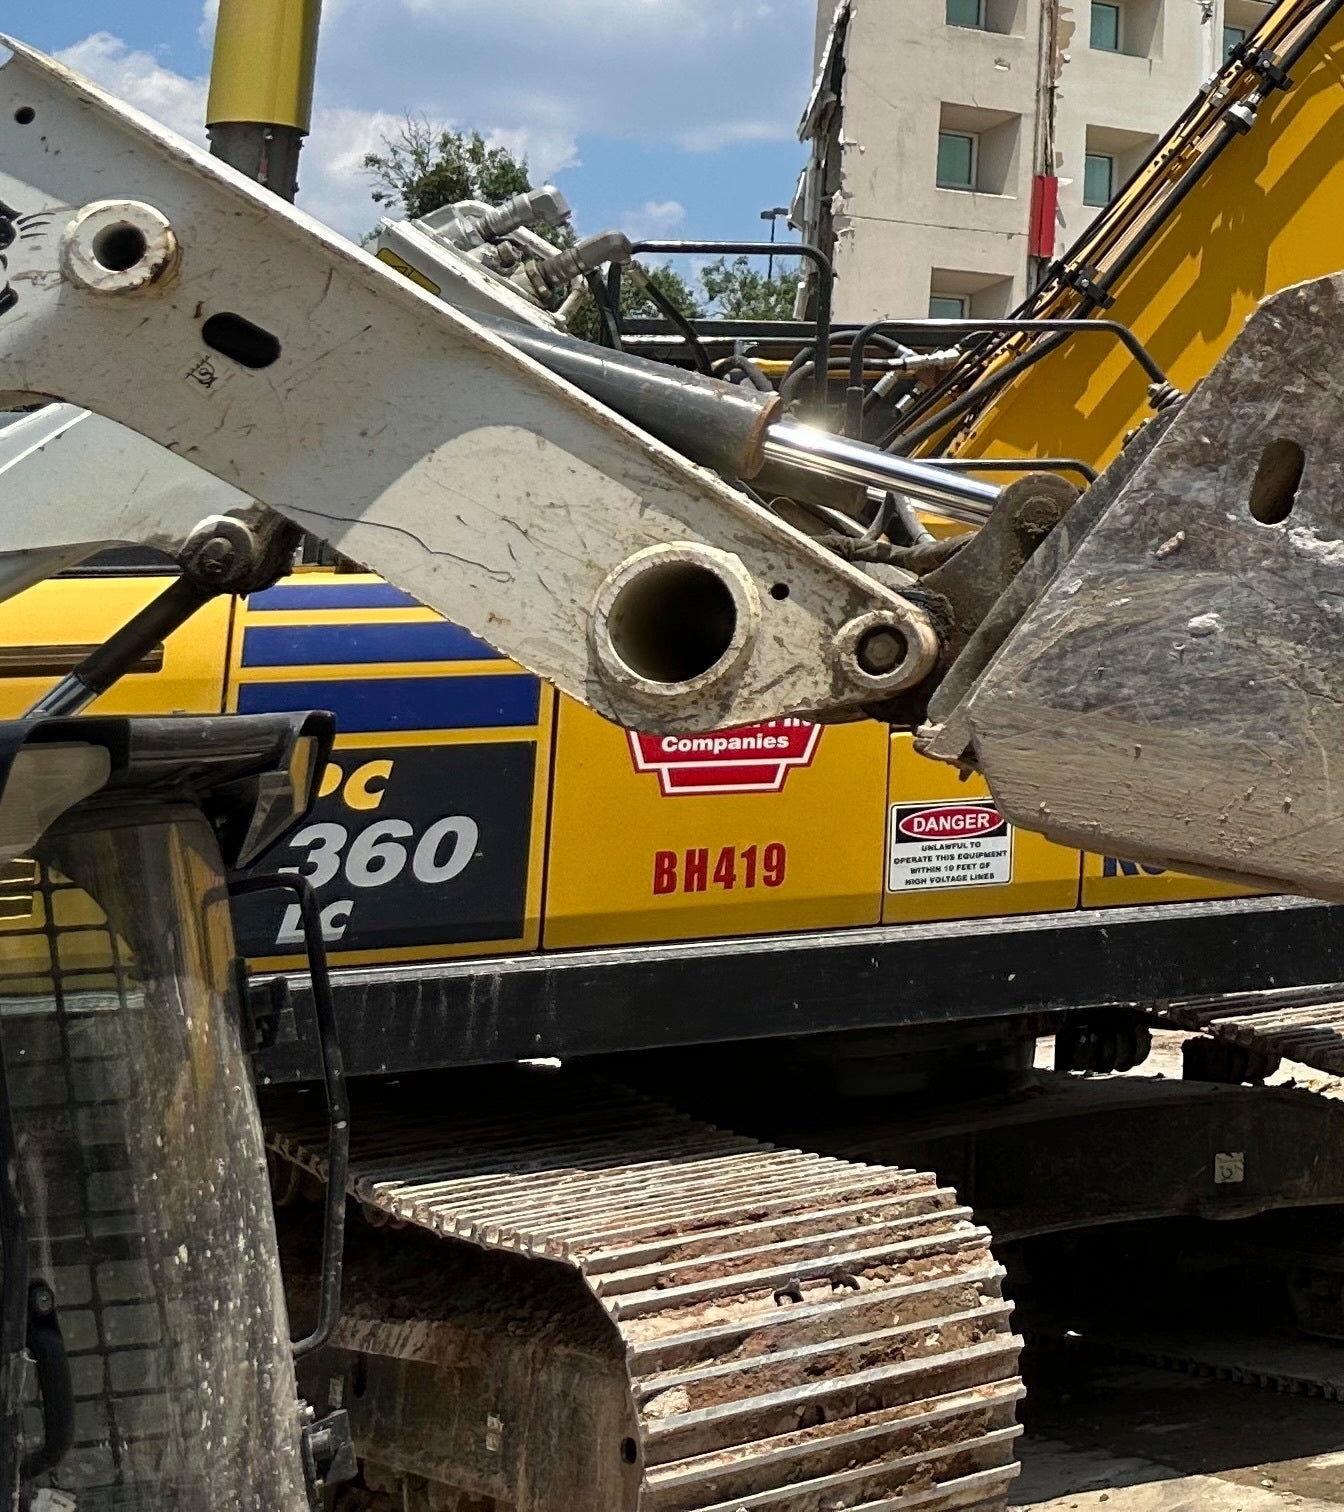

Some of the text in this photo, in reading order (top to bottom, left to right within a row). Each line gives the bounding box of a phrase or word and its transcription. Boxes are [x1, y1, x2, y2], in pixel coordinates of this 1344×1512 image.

[661, 732, 790, 755] Companies
[913, 813, 990, 833] DANGER
[277, 815, 479, 890] 360
[921, 841, 981, 852] UNLAWFUL TO
[893, 850, 1008, 865] OPERATE THIS EQUIPMENT
[652, 842, 787, 896] BH419
[910, 865, 941, 875] WITHIN
[956, 863, 977, 871] FEET
[979, 862, 990, 870] OF
[905, 872, 995, 886] HIGH VOLTAGE LINES
[275, 899, 355, 945] LC
